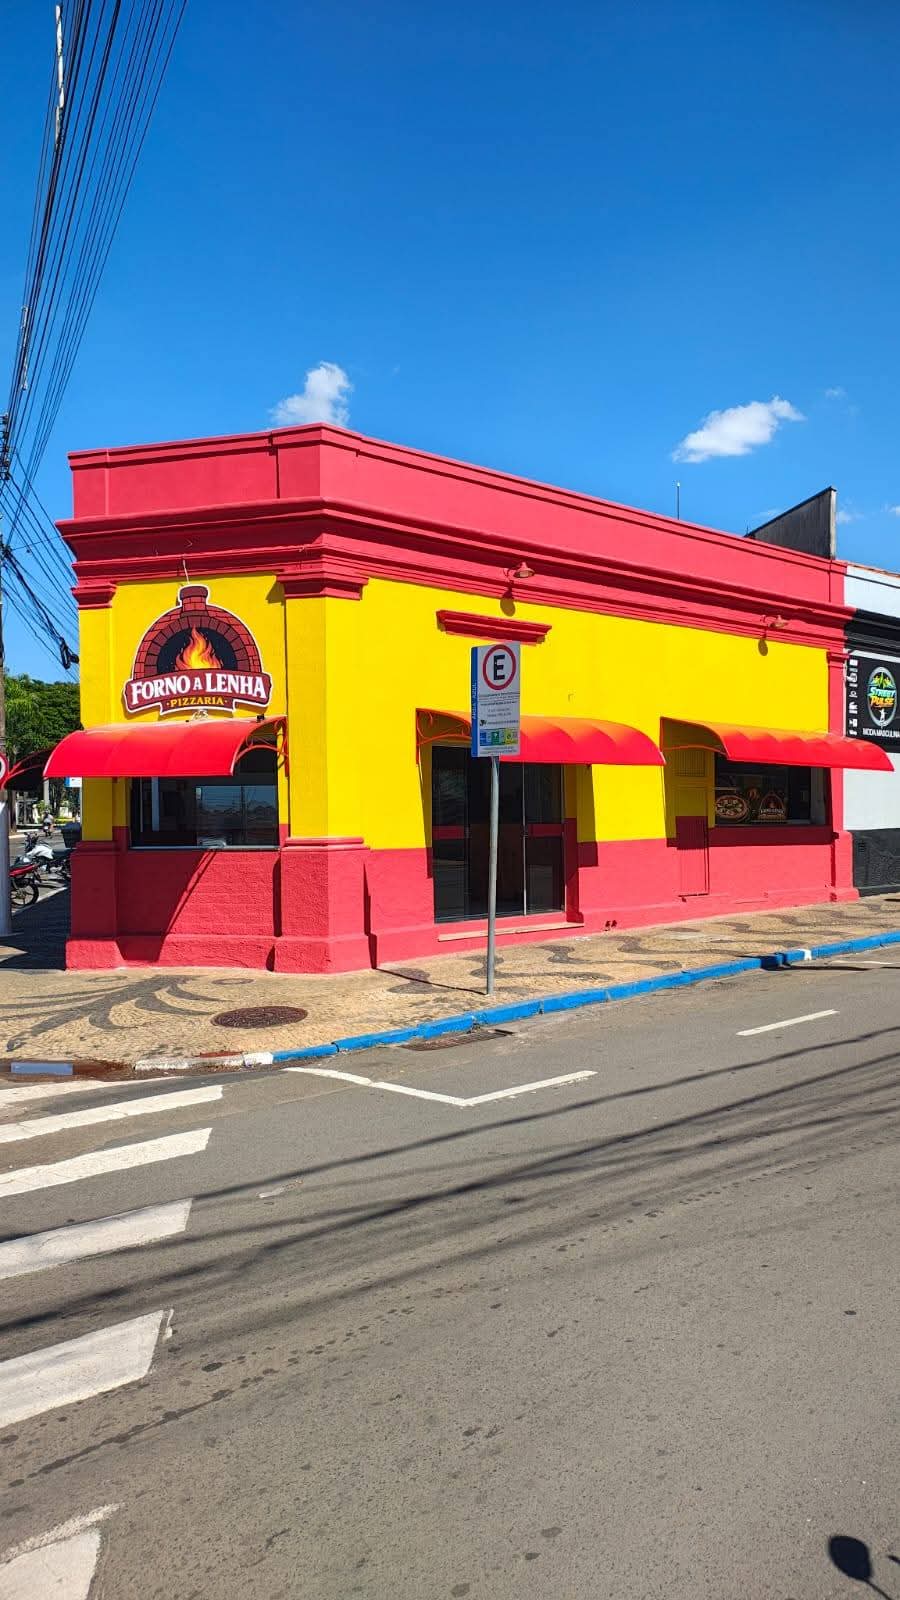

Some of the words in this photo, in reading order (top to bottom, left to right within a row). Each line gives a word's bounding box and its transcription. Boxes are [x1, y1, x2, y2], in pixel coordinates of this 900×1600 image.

[493, 654, 505, 680] E
[130, 675, 190, 705] FORNO
[193, 677, 203, 690] A
[205, 672, 267, 699] LENHA
[870, 687, 896, 697] STREET
[170, 697, 224, 708] PIZZARIA
[870, 696, 894, 706] PULSE
[862, 727, 876, 736] MODA
